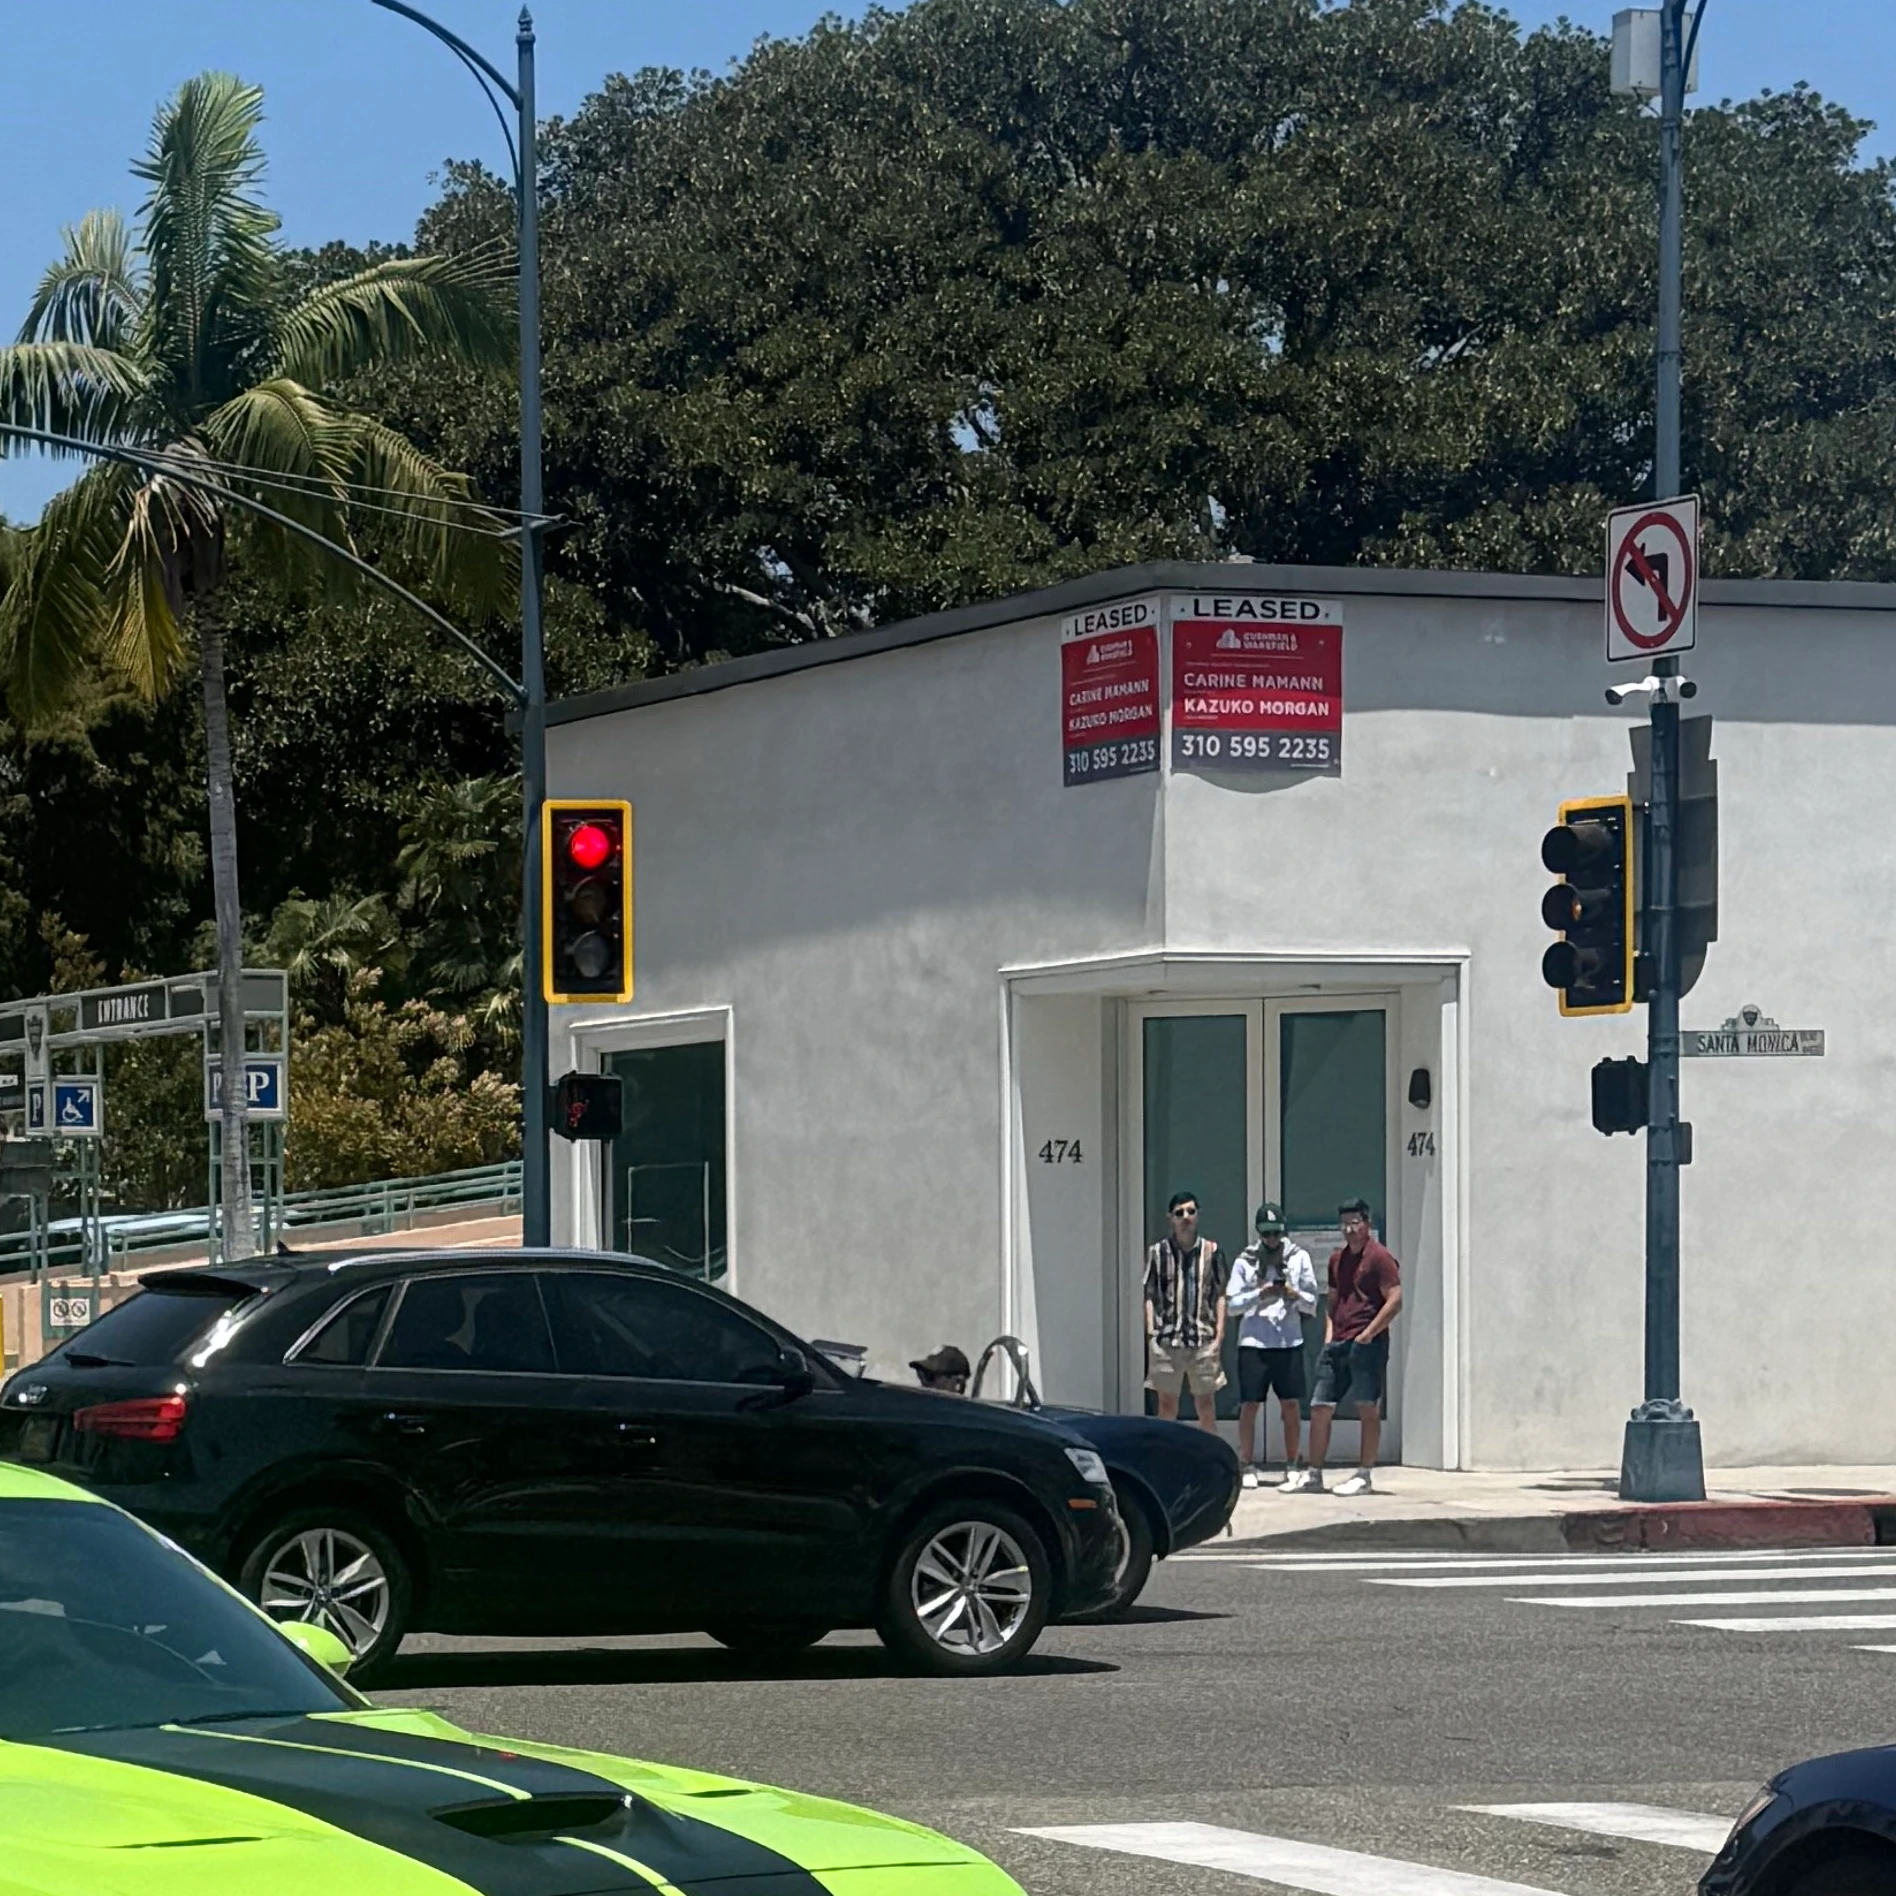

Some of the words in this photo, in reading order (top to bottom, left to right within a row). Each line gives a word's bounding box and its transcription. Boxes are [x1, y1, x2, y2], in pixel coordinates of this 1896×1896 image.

[1074, 604, 1147, 636] LEASED
[1194, 598, 1320, 620] LEASED
[1184, 673, 1246, 688] CARINE
[1253, 675, 1323, 690] MAMANN
[1184, 698, 1254, 714] KAZUKO
[1260, 701, 1329, 716] MORGAN
[1069, 751, 1089, 774] 310
[1093, 747, 1117, 770] 595
[1121, 740, 1155, 765] 2235
[1182, 735, 1221, 756] 310
[1230, 736, 1270, 758] 595
[1278, 738, 1330, 760] 2235
[98, 994, 149, 1024] ENTRANCE
[1696, 1031, 1739, 1053] SANTA
[1747, 1032, 1799, 1053] MONICA
[247, 1071, 269, 1102] P
[1038, 1139, 1083, 1163] 474
[1407, 1132, 1435, 1156] 474
